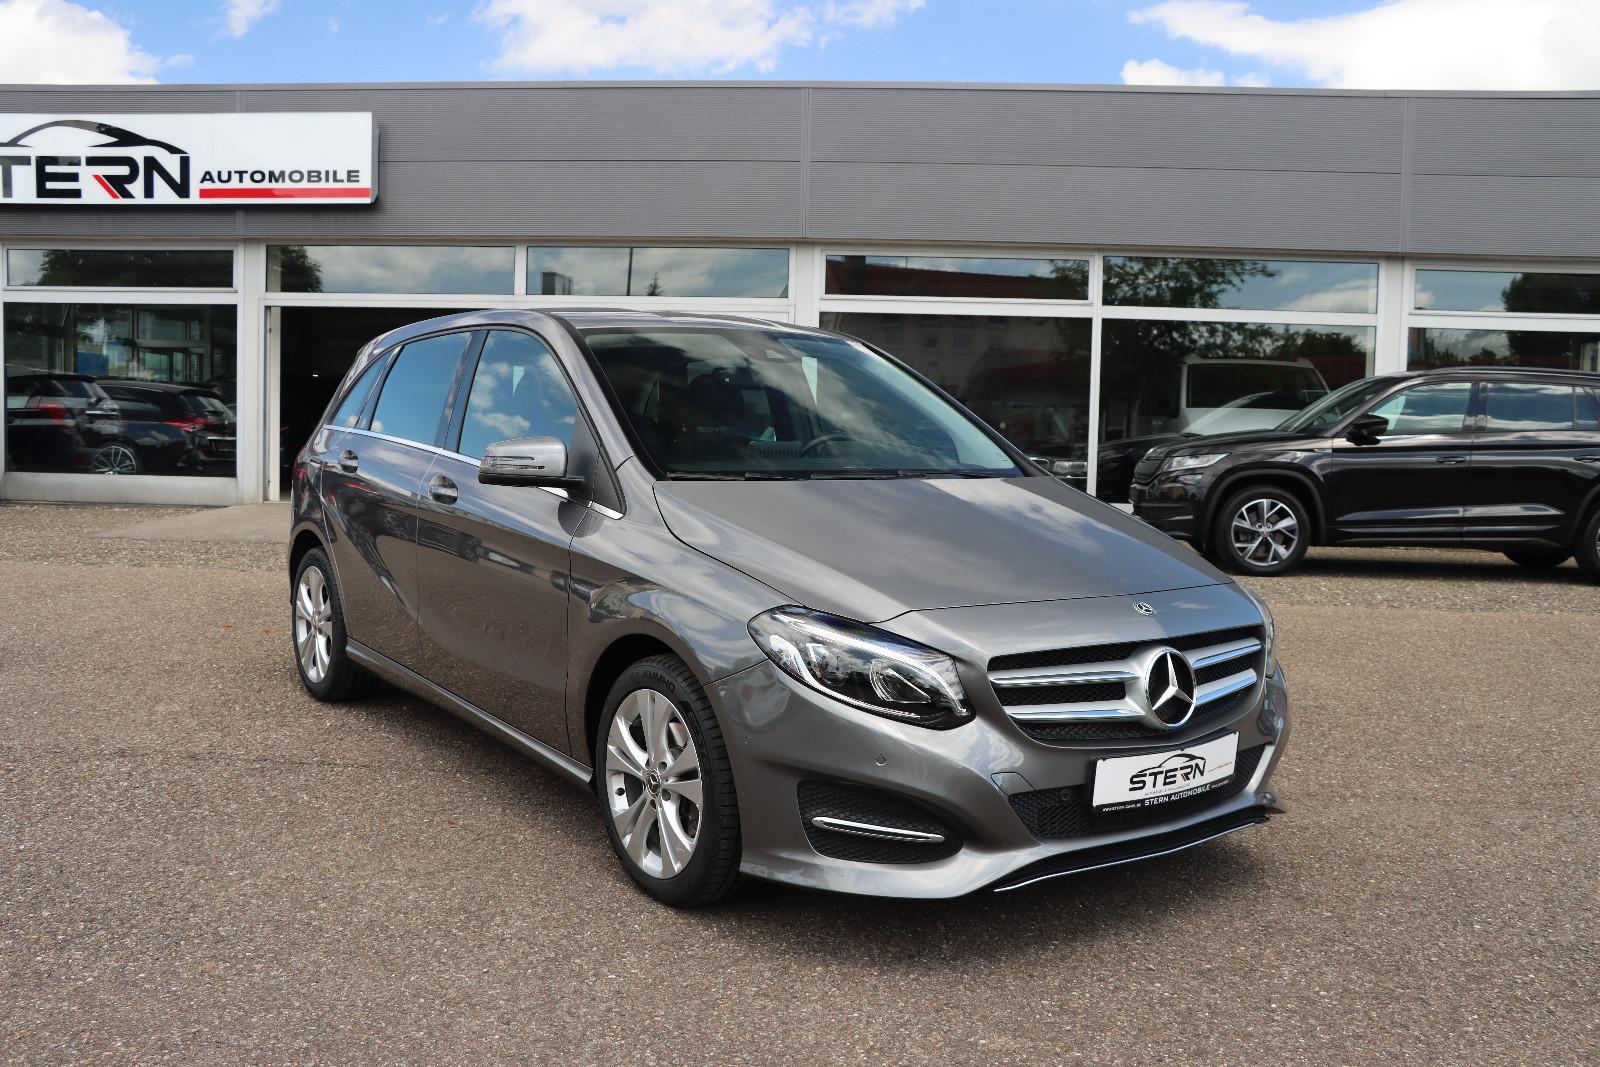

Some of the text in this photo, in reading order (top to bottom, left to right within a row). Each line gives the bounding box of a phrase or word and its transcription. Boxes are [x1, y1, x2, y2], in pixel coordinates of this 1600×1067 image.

[200, 169, 360, 184] AUTOMOBILE
[643, 671, 675, 692] KUMHO
[1129, 762, 1206, 792] STERN
[1144, 796, 1169, 806] STERN
[1170, 784, 1210, 801] AUTOMOBILE
